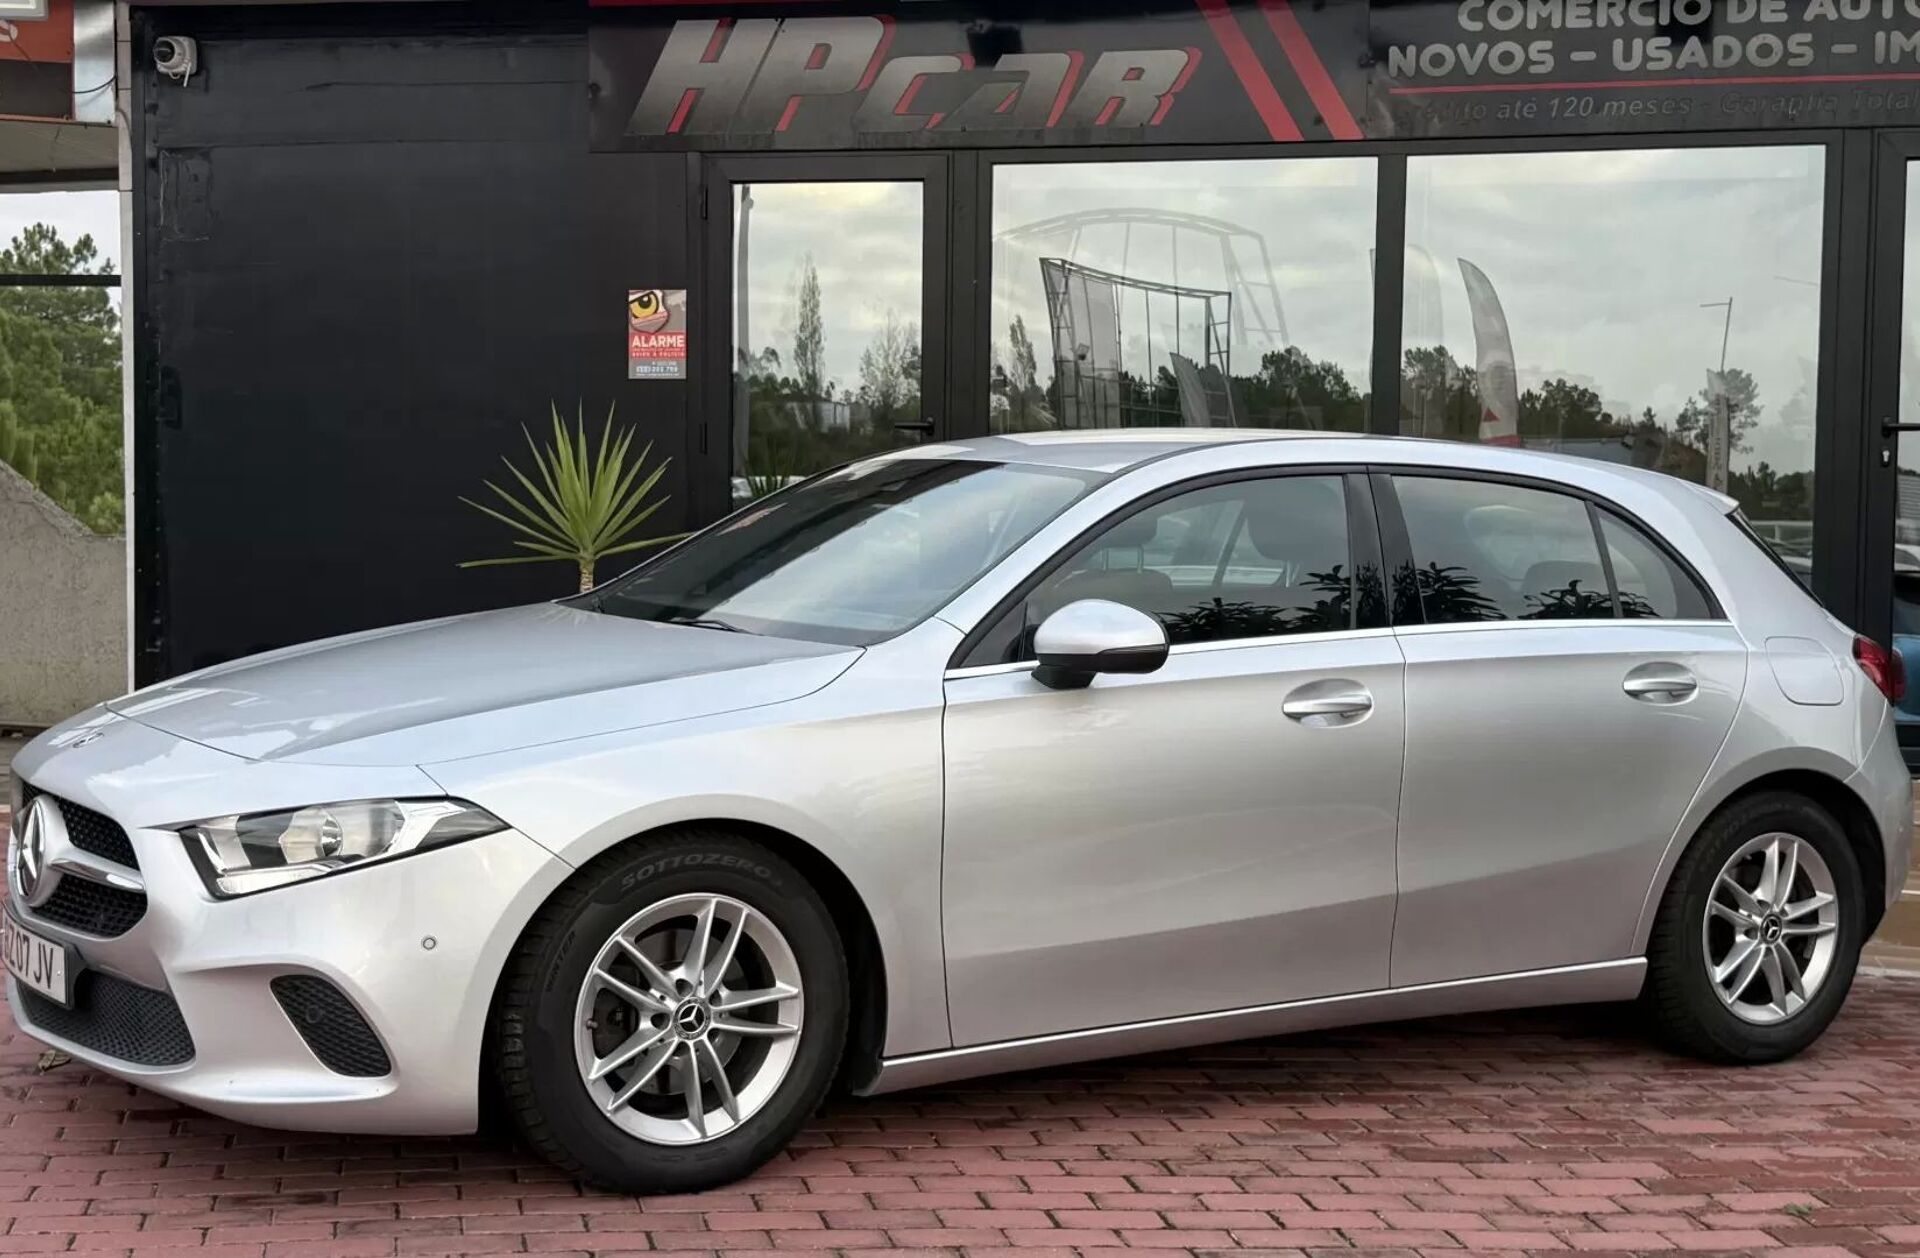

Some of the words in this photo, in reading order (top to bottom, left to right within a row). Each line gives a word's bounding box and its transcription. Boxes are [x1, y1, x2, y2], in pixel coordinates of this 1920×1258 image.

[1727, 0, 1789, 24] DE
[1388, 40, 1555, 77] NOVOS
[1612, 33, 1814, 72] USADOS
[1496, 97, 1538, 119] até
[1549, 95, 1594, 118] 120
[1602, 97, 1691, 117] meses
[632, 335, 685, 348] ALARME
[620, 853, 772, 892] SOTTOZERO
[33, 943, 54, 989] JV
